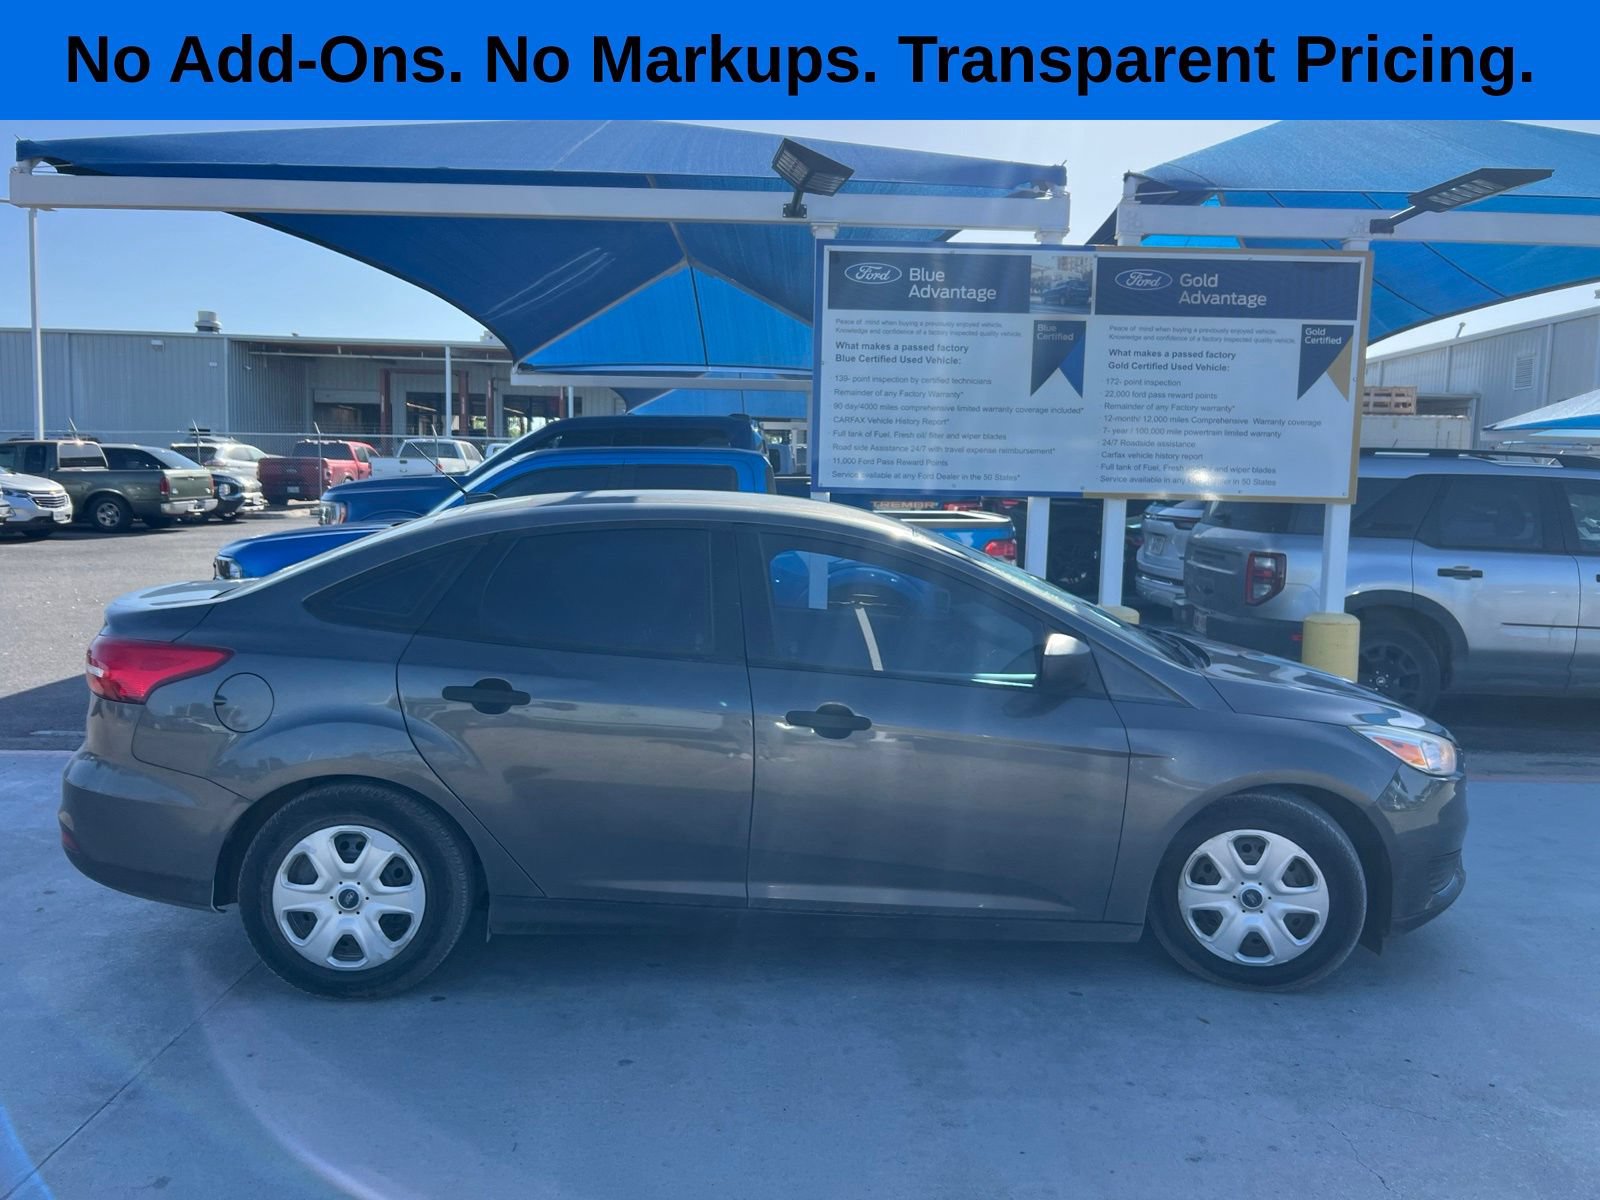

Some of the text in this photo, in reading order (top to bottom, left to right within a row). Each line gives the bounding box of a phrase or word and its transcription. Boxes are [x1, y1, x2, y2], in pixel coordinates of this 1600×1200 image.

[855, 265, 891, 281] Ford
[910, 268, 944, 282] Blue
[1126, 272, 1162, 287] Ford
[1180, 274, 1218, 287] Gold
[908, 284, 996, 302] Advantage
[1178, 290, 1266, 308] Advantage
[1037, 323, 1056, 332] Blue
[1305, 328, 1326, 336] Gold
[1036, 332, 1074, 341] Certified
[1304, 336, 1342, 345] Certified
[836, 342, 859, 350] What
[861, 342, 891, 351] makes
[901, 342, 935, 354] passed
[937, 343, 969, 354] factory
[836, 354, 961, 364] Blue Certified Used Vehicle:
[1109, 348, 1132, 357] What
[1133, 348, 1162, 357] makes
[1171, 349, 1204, 360] passed
[1205, 350, 1236, 361] factory
[1109, 361, 1230, 372] Gold Certified Used Vehicle:
[852, 375, 870, 385] point
[872, 375, 908, 386] inspection
[910, 376, 919, 386] by
[921, 376, 950, 384] certified
[951, 376, 992, 385] technicians
[1106, 377, 1181, 388] 172- point inspection
[835, 388, 873, 397] Remainder
[875, 389, 882, 397] of
[884, 391, 897, 399] any
[899, 389, 926, 400] Factory
[1105, 390, 1217, 401] 22,000 ford pass reward points
[834, 402, 843, 410] 90
[879, 403, 898, 411] miles
[900, 403, 955, 414] comprehensive
[956, 404, 980, 412] limited
[982, 404, 1013, 415] warranty
[1015, 406, 1048, 415] coverage
[1105, 402, 1144, 410] Remainder
[1146, 402, 1153, 410] of
[1155, 404, 1169, 413] any
[1170, 403, 1198, 413] Factory
[834, 416, 865, 424] CARFAX
[867, 416, 893, 424] Vehicle
[895, 416, 920, 427] History
[1143, 415, 1168, 424] 12,000
[1170, 415, 1189, 424] miles
[1190, 416, 1248, 427] Comprehensive
[1252, 416, 1286, 427] Warranty
[1287, 419, 1322, 428] coverage
[833, 429, 846, 437] Full
[848, 429, 863, 438] tank
[865, 430, 872, 438] of
[893, 430, 914, 438] Fresh
[946, 431, 959, 439] and
[961, 431, 981, 442] wiper
[982, 432, 1006, 440] blades
[1112, 427, 1128, 436] year
[1166, 426, 1182, 435] mile
[1184, 427, 1222, 438] powertrain
[1224, 428, 1248, 436] limited
[1250, 428, 1281, 439] warranty
[1103, 438, 1196, 447] 24/7 Roadside assistance
[833, 442, 852, 451] Road
[853, 443, 868, 451] side
[870, 443, 908, 452] Assistance
[910, 444, 926, 452] 24/7
[928, 444, 942, 452] with
[944, 444, 964, 452] travel
[966, 446, 997, 455] expense
[858, 457, 874, 465] Ford
[876, 457, 894, 465] Pass
[896, 457, 924, 466] Reward
[926, 458, 948, 466] Points
[1102, 450, 1203, 462] Carfax vehicle history report
[1101, 462, 1114, 471] Full
[1116, 463, 1132, 471] tank
[1133, 463, 1141, 471] of
[1162, 464, 1184, 472] Fresh
[1230, 465, 1250, 475] wiper
[1251, 465, 1276, 474] blades
[893, 471, 900, 479] at
[902, 473, 916, 481] any
[917, 471, 934, 479] Ford
[936, 471, 960, 480] Dealer
[961, 472, 968, 480] in
[970, 472, 982, 480] the
[983, 472, 992, 480] 50
[1101, 475, 1127, 483] Service
[1129, 475, 1162, 484] available
[1164, 476, 1170, 484] in
[1172, 478, 1185, 486] any
[1232, 477, 1239, 485] in
[1241, 477, 1251, 485] 50
[1252, 477, 1276, 486] States
[870, 500, 934, 509] TREMOR
